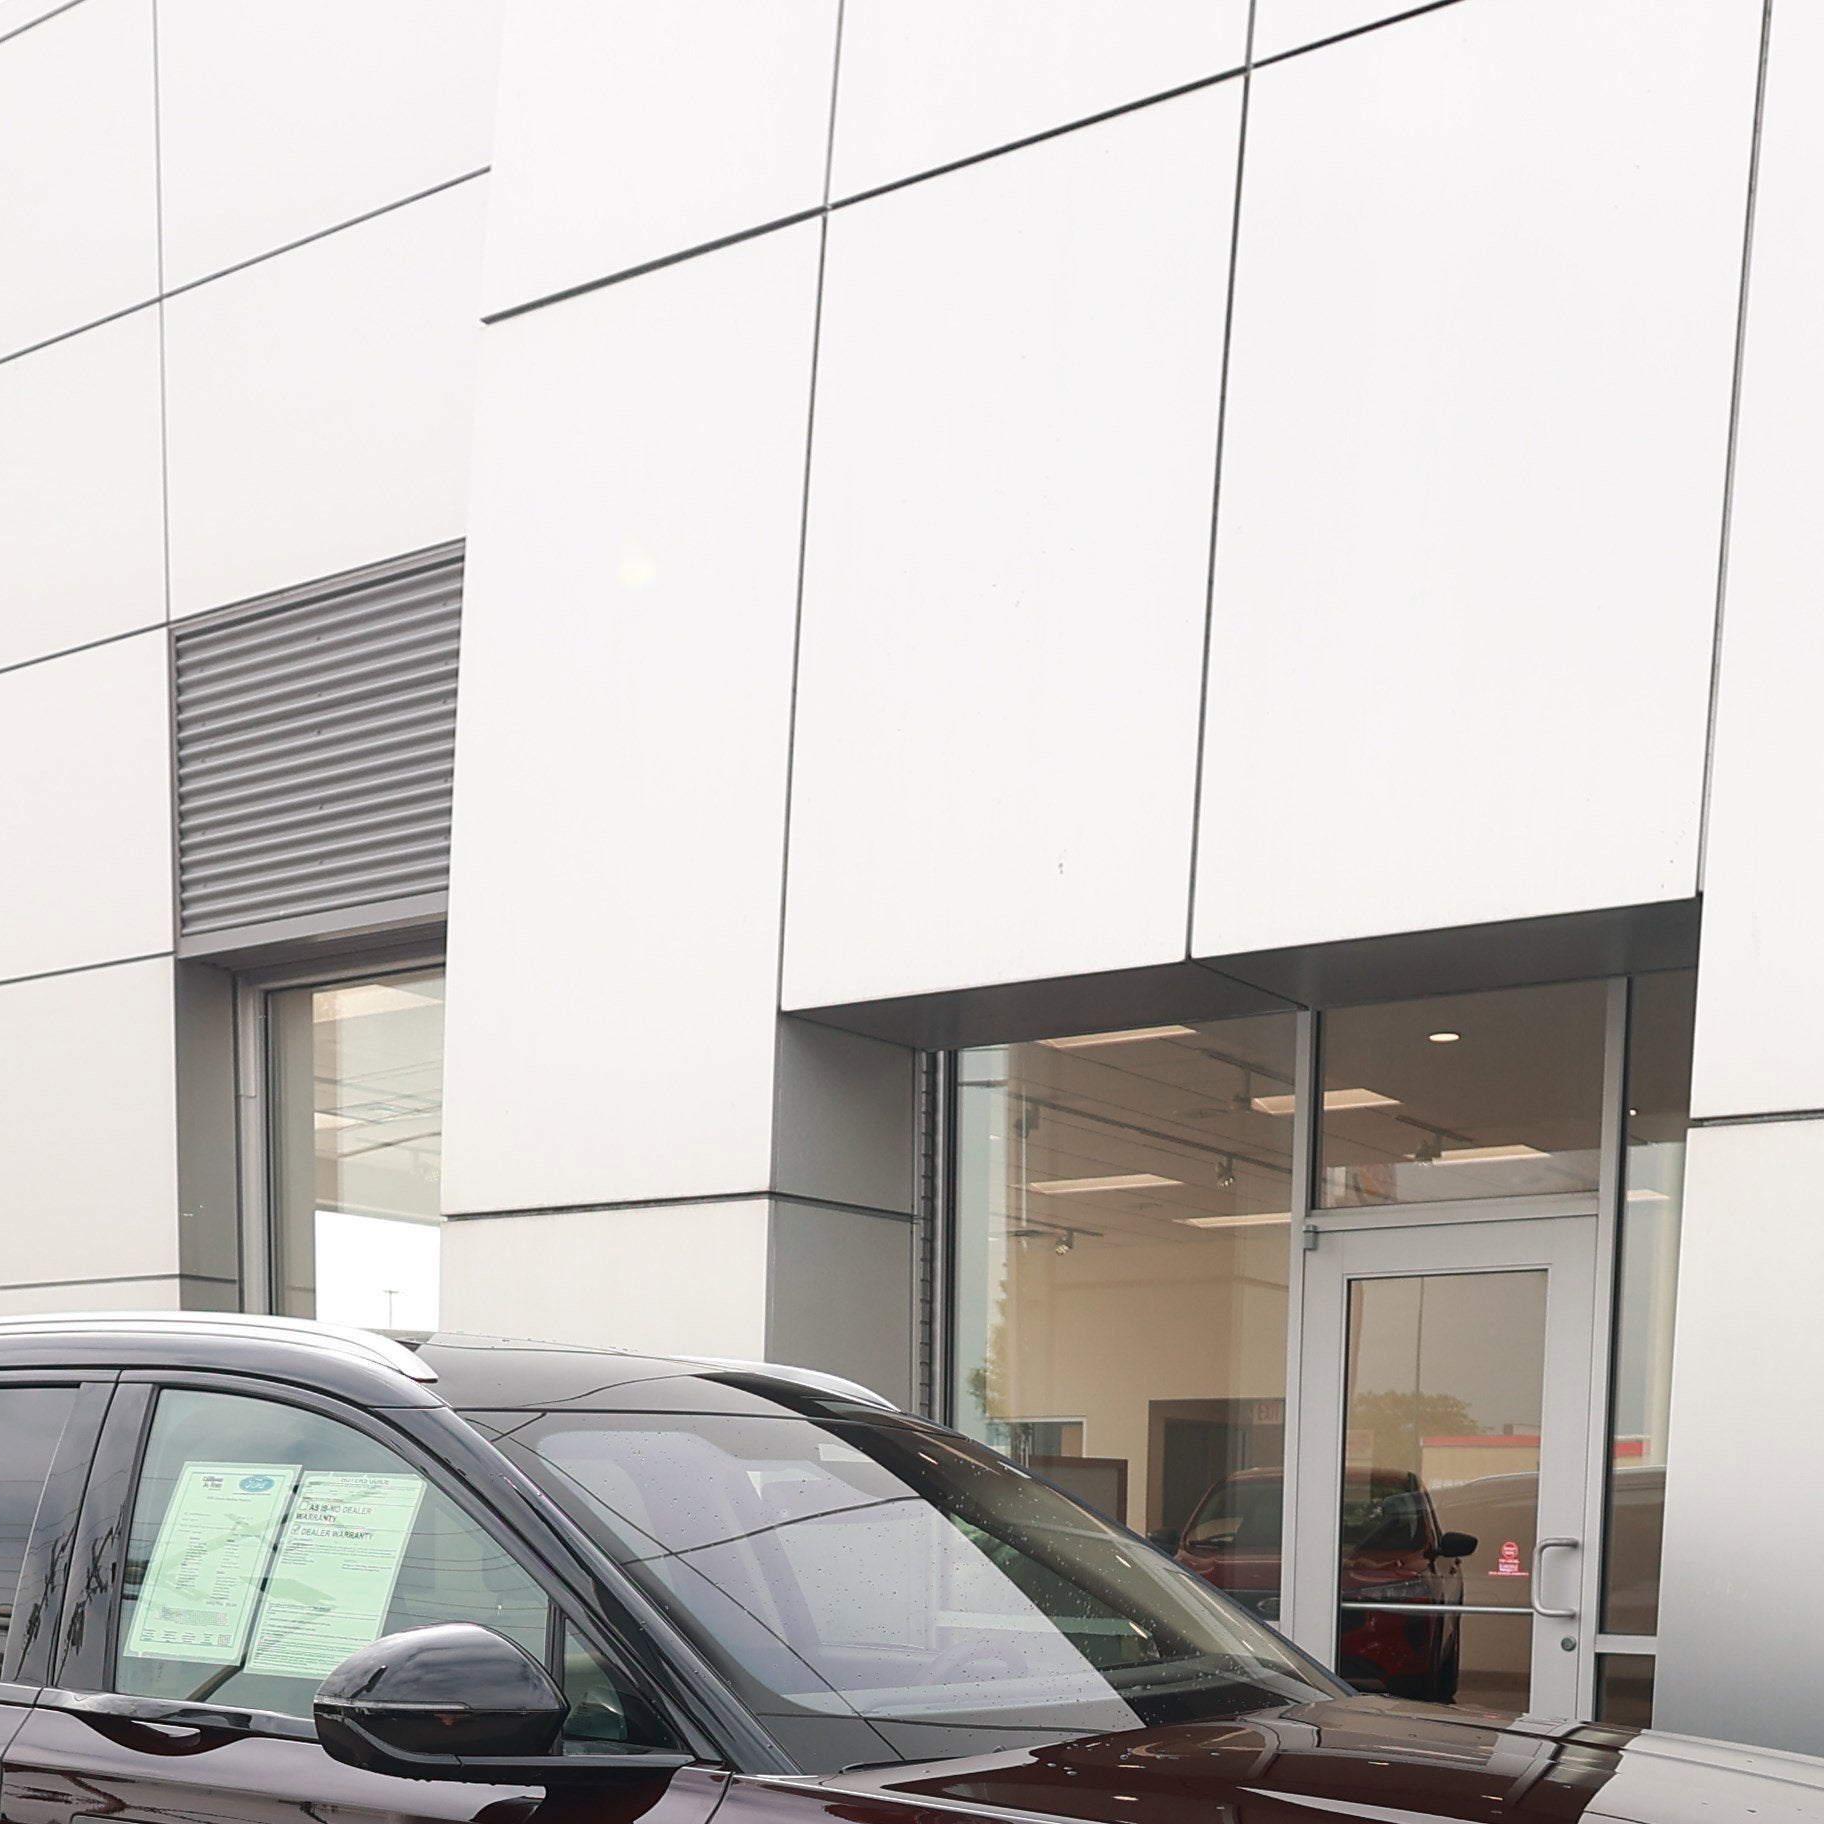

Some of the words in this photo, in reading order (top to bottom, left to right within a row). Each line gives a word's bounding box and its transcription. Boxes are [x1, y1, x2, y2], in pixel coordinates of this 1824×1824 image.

[341, 1506, 372, 1516] DEALER
[295, 1513, 337, 1523] WARRANTY
[301, 1528, 331, 1538] DEALER
[331, 1530, 374, 1541] WARRANTY
